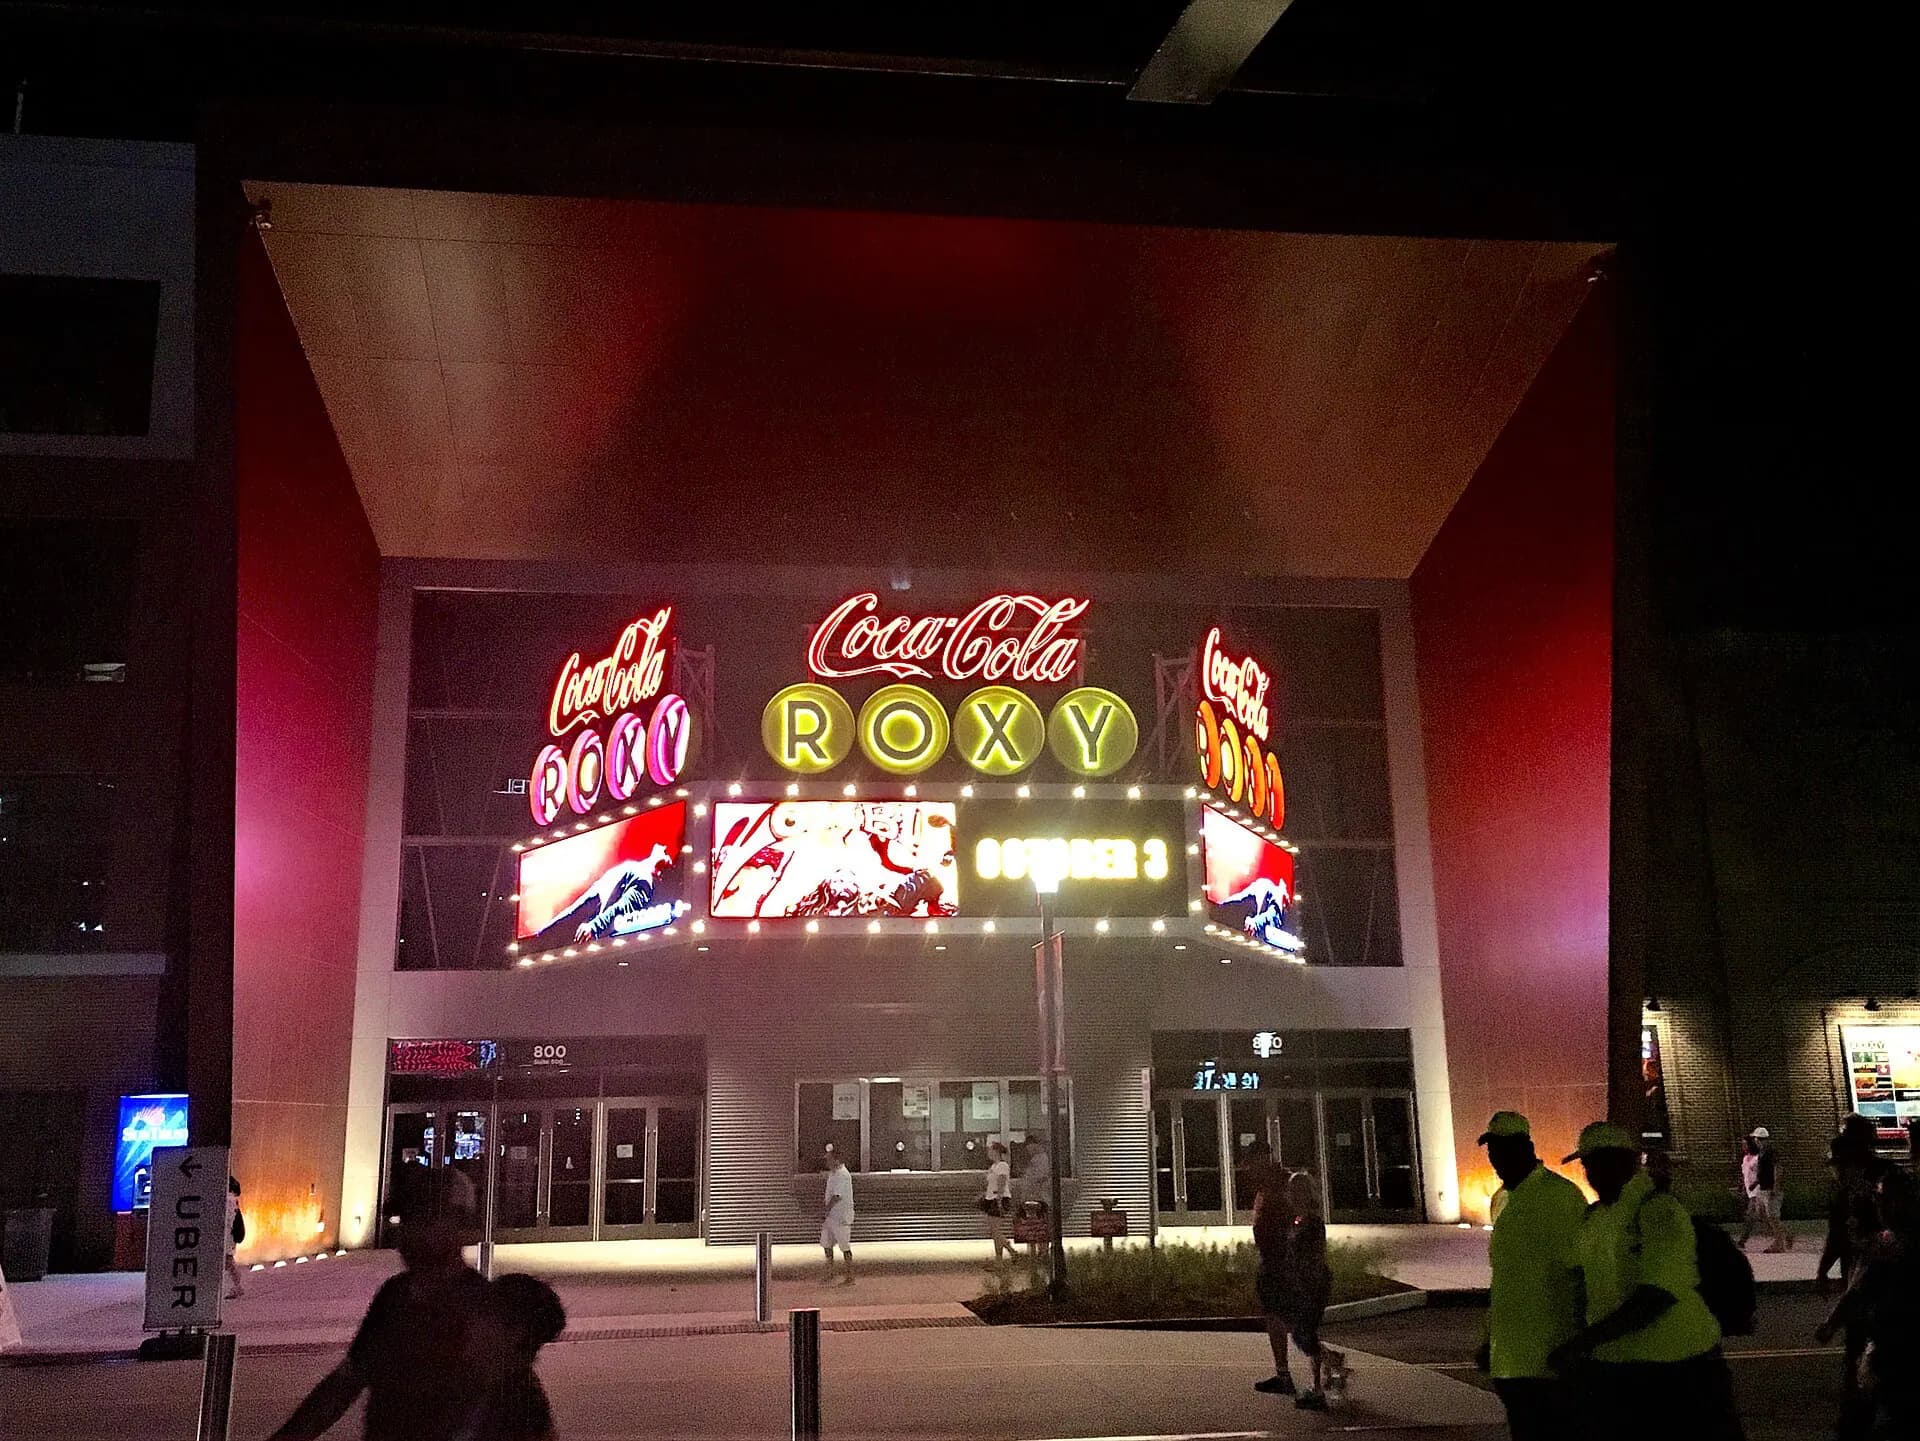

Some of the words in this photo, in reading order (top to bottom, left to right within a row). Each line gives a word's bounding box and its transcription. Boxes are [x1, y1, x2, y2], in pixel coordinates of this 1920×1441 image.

[550, 606, 672, 737] Coca-Cola
[808, 593, 1090, 682] Coca-Cola
[536, 697, 690, 822] ROXY
[780, 696, 1116, 770] ROXY
[1143, 838, 1168, 879] 3
[533, 1045, 567, 1058] 800
[1252, 1036, 1282, 1049] 80
[171, 1195, 200, 1309] UBER
